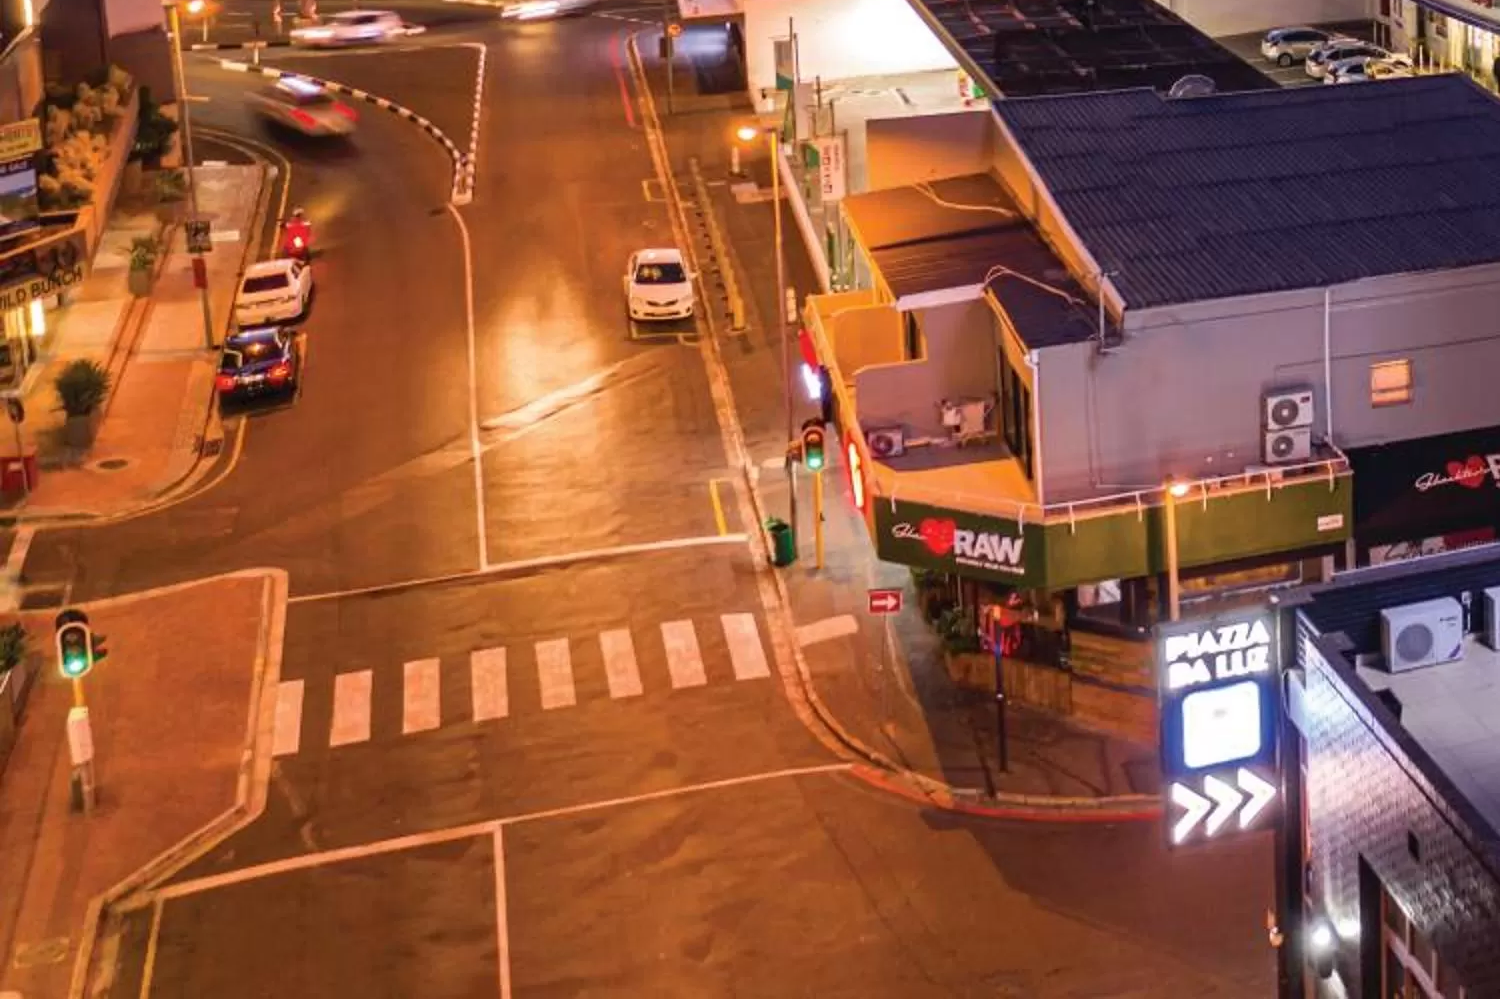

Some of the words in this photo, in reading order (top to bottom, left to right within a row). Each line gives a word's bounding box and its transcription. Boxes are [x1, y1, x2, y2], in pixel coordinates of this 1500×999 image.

[0, 288, 27, 310] ILD
[31, 265, 83, 298] BUNCH
[953, 528, 1024, 565] RAW
[1166, 620, 1270, 662] PIAZZA
